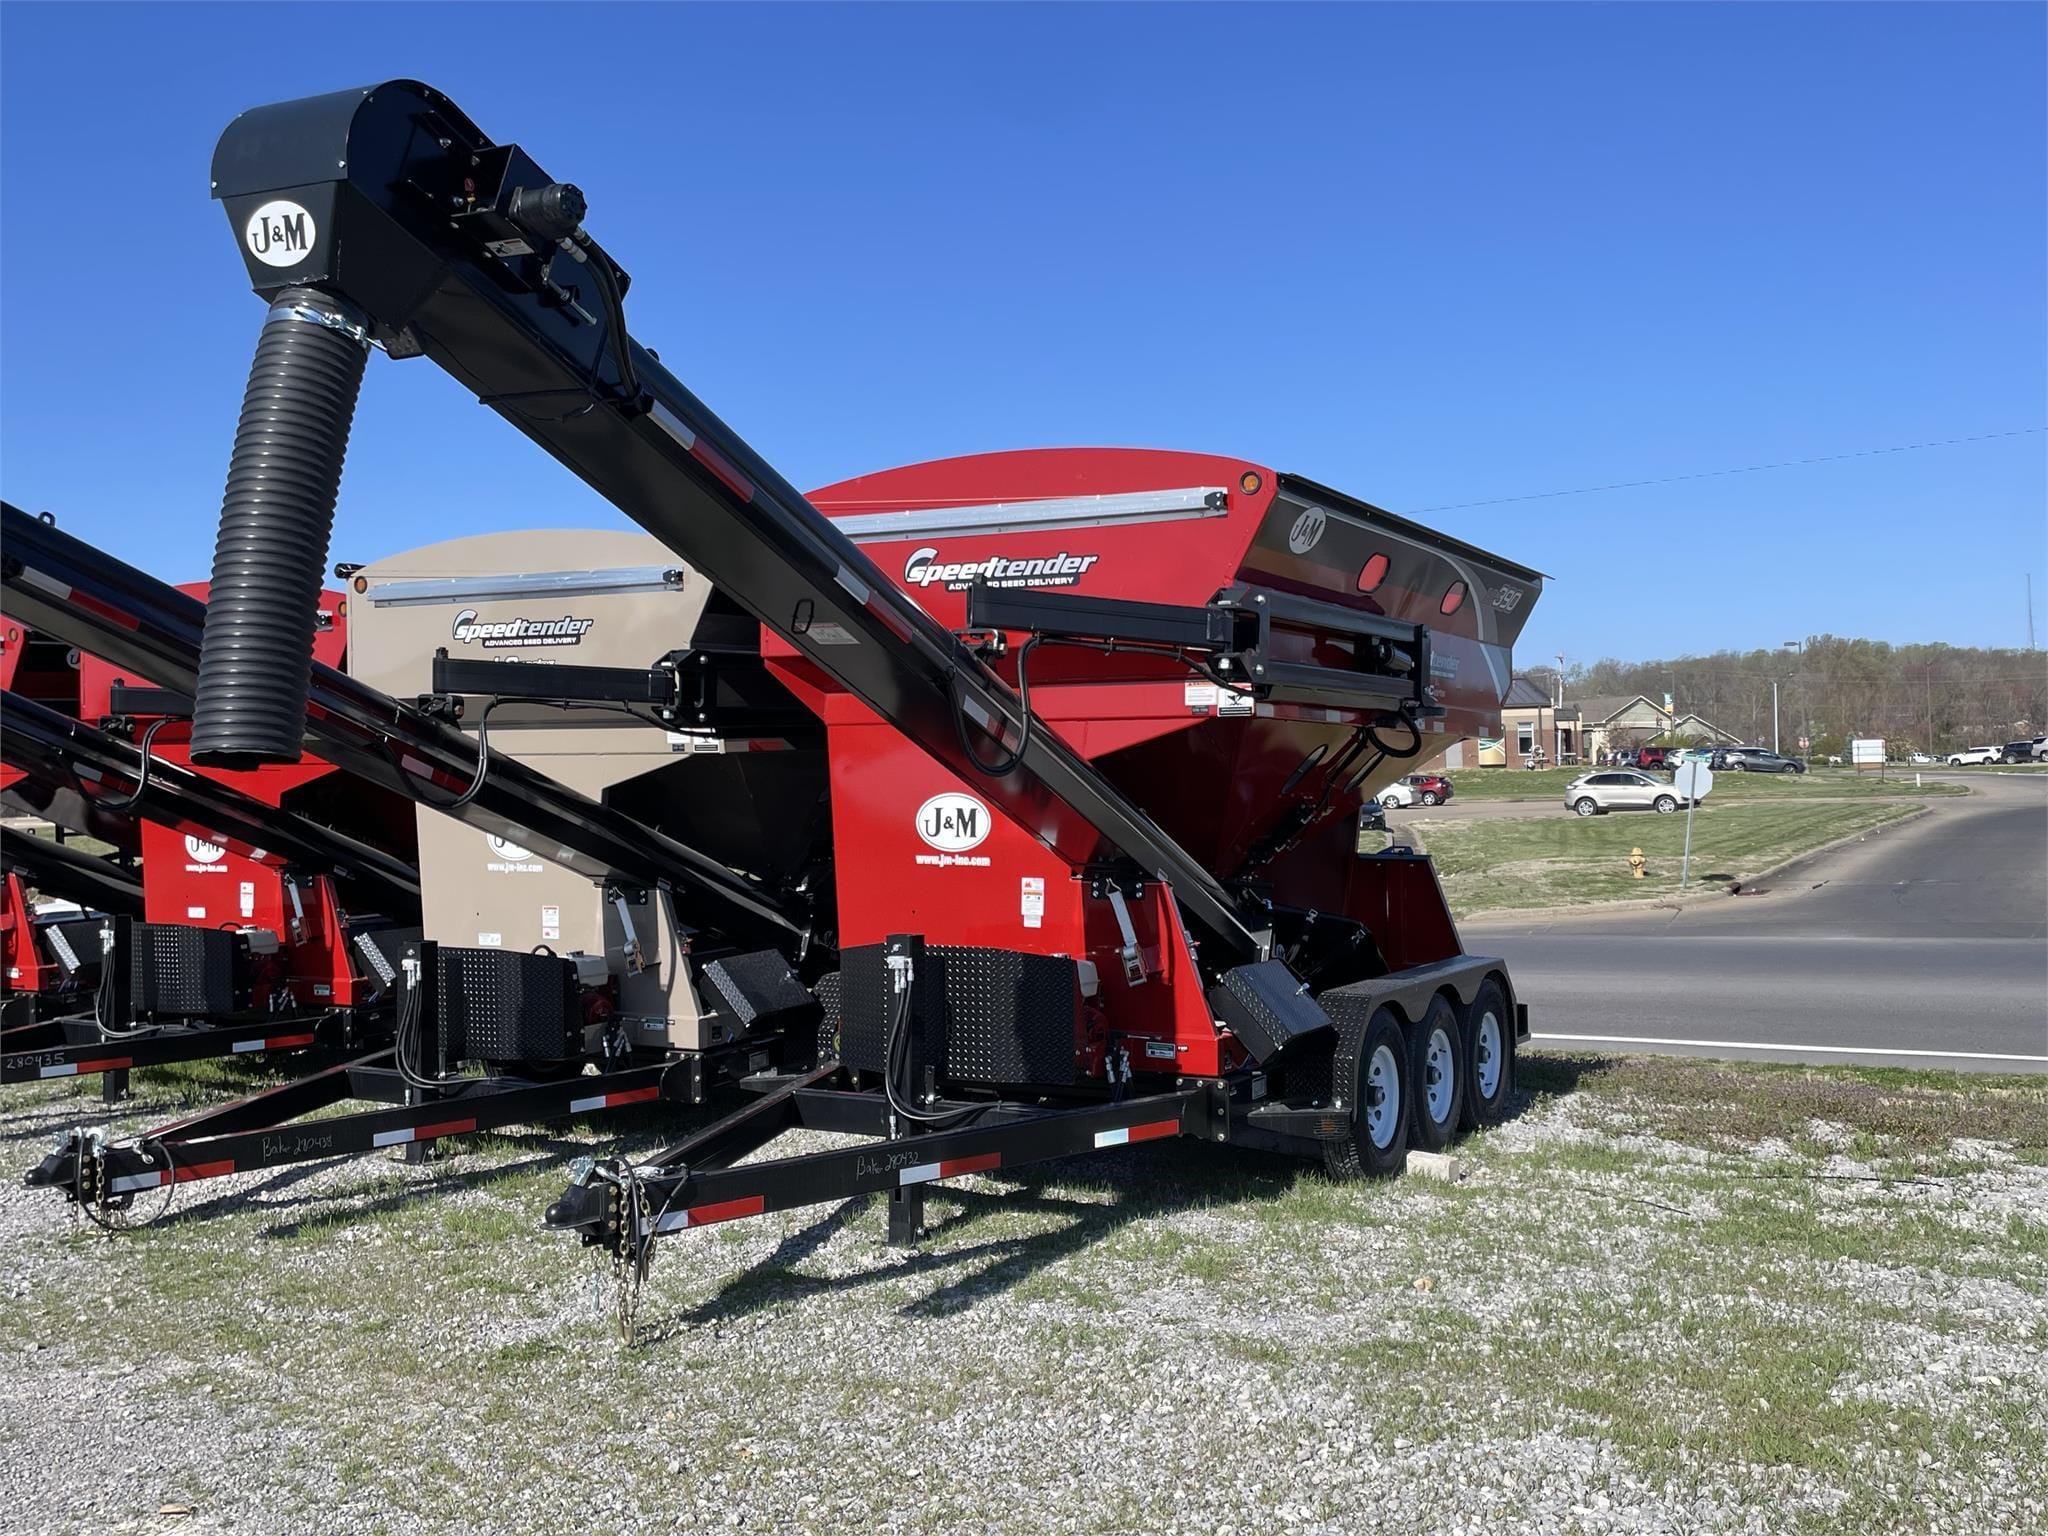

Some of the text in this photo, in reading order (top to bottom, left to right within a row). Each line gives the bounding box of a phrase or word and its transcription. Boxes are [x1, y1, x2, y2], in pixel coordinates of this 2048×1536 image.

[252, 213, 308, 254] J&M
[1290, 515, 1324, 547] J&M
[904, 547, 1098, 586] Speedtender
[1001, 578, 1025, 587] SEED
[1027, 577, 1074, 587] DELIVERY
[453, 609, 593, 643] Speedtender
[484, 638, 522, 647] ADVANCED
[543, 636, 577, 645] DELIVERY
[924, 807, 979, 838] J&M
[915, 854, 991, 867] www.jm-inc.com
[6, 1052, 65, 1069] 280435
